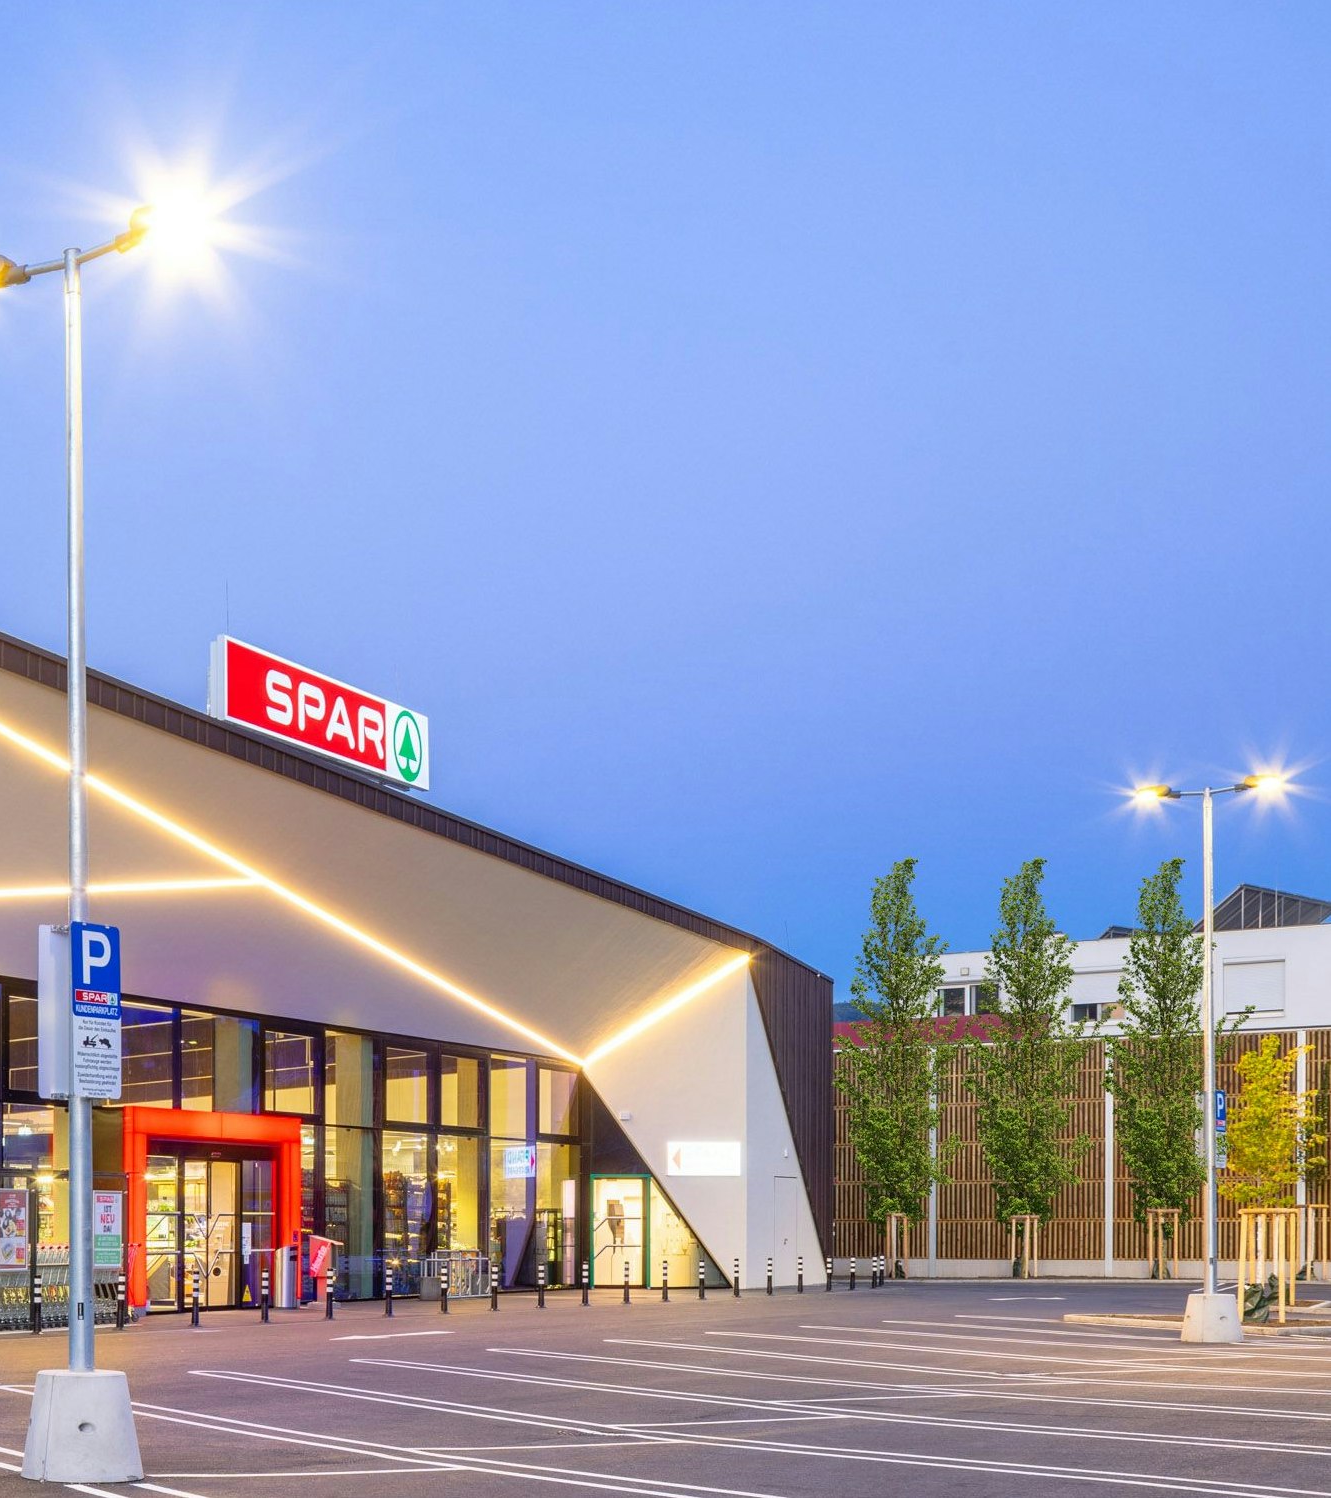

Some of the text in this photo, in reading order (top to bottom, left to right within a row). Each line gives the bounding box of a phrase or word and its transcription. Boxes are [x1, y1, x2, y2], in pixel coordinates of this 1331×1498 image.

[265, 669, 385, 760] SPAR
[82, 930, 112, 985] P
[82, 992, 108, 1003] SPAR
[75, 1004, 118, 1016] KUNDENPARKPLATZ
[1216, 1093, 1224, 1118] P
[100, 1213, 115, 1224] NEU
